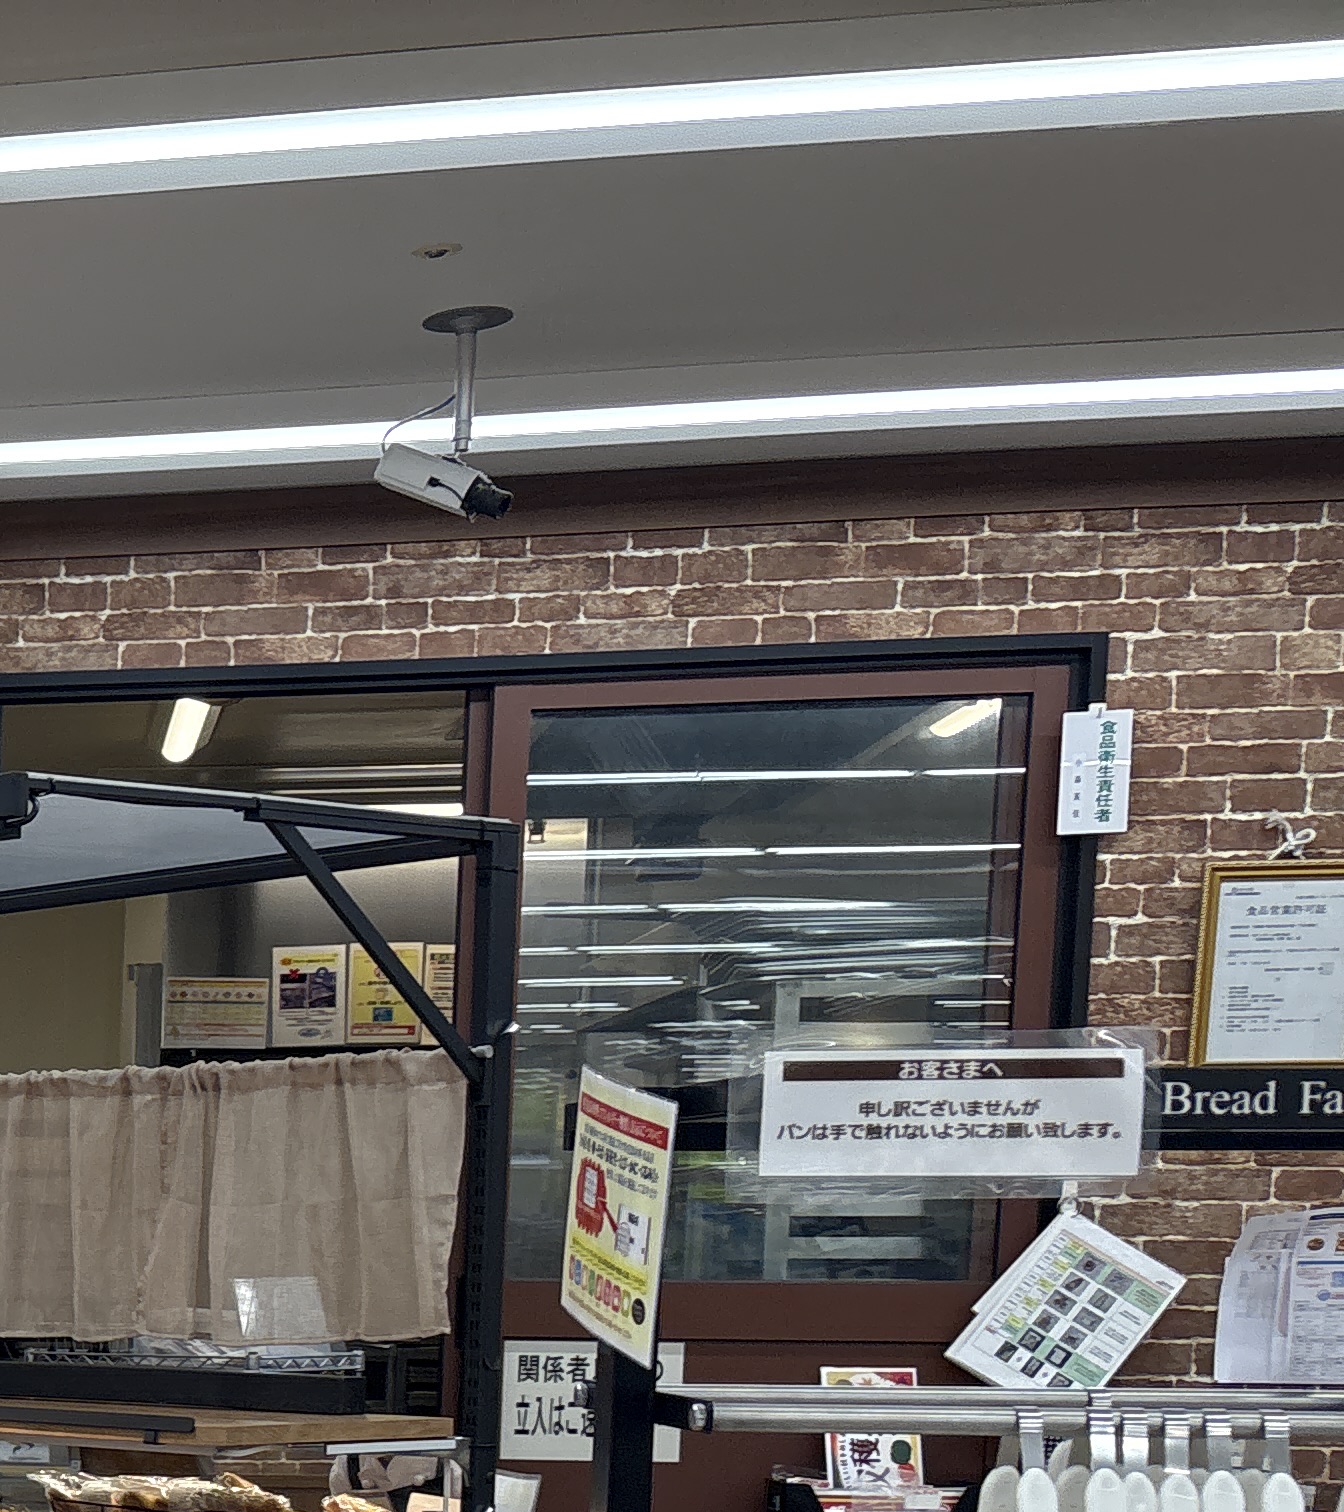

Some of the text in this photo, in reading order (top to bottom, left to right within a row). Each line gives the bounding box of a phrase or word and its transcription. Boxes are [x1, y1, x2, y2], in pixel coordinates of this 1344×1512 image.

[1094, 720, 1117, 822] 食品衛生責任者
[898, 1061, 1004, 1080] お客さまへ
[858, 1100, 1041, 1117] 申し訳ございませんが
[1160, 1080, 1278, 1115] Bread
